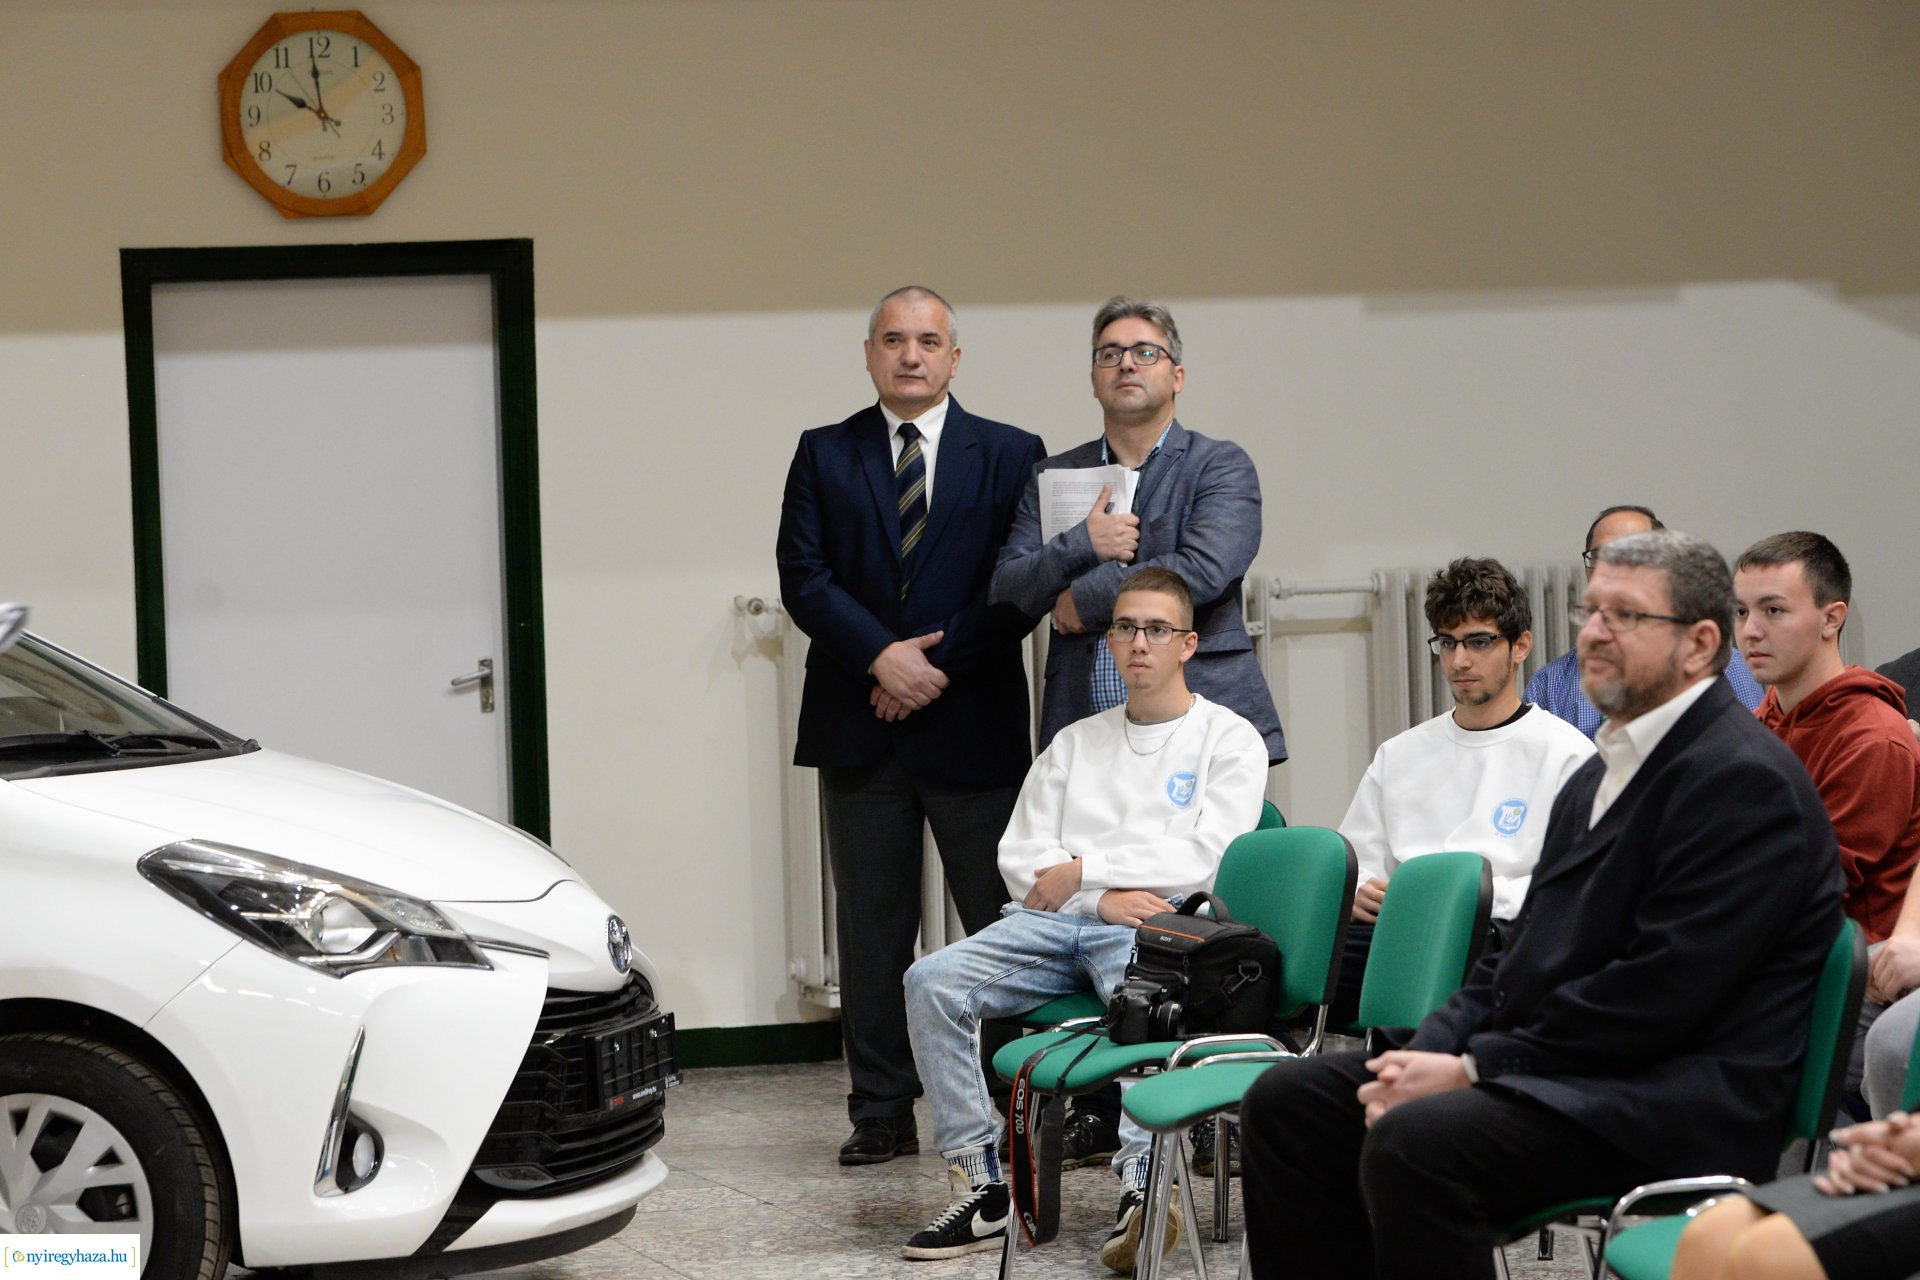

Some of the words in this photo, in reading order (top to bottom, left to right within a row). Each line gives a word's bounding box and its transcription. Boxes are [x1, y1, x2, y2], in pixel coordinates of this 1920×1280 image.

[274, 47, 290, 69] 11
[308, 36, 331, 58] 12
[352, 46, 360, 68] 1
[253, 71, 273, 94] 10
[373, 73, 386, 92] 2
[248, 105, 261, 128] 9
[382, 105, 394, 125] 3
[259, 141, 271, 162] 8
[372, 140, 385, 161] 4
[285, 164, 297, 187] 7
[317, 171, 331, 194] 6
[352, 163, 366, 186] 5
[1015, 1078, 1026, 1111] EOS
[1015, 1113, 1025, 1135] 70D
